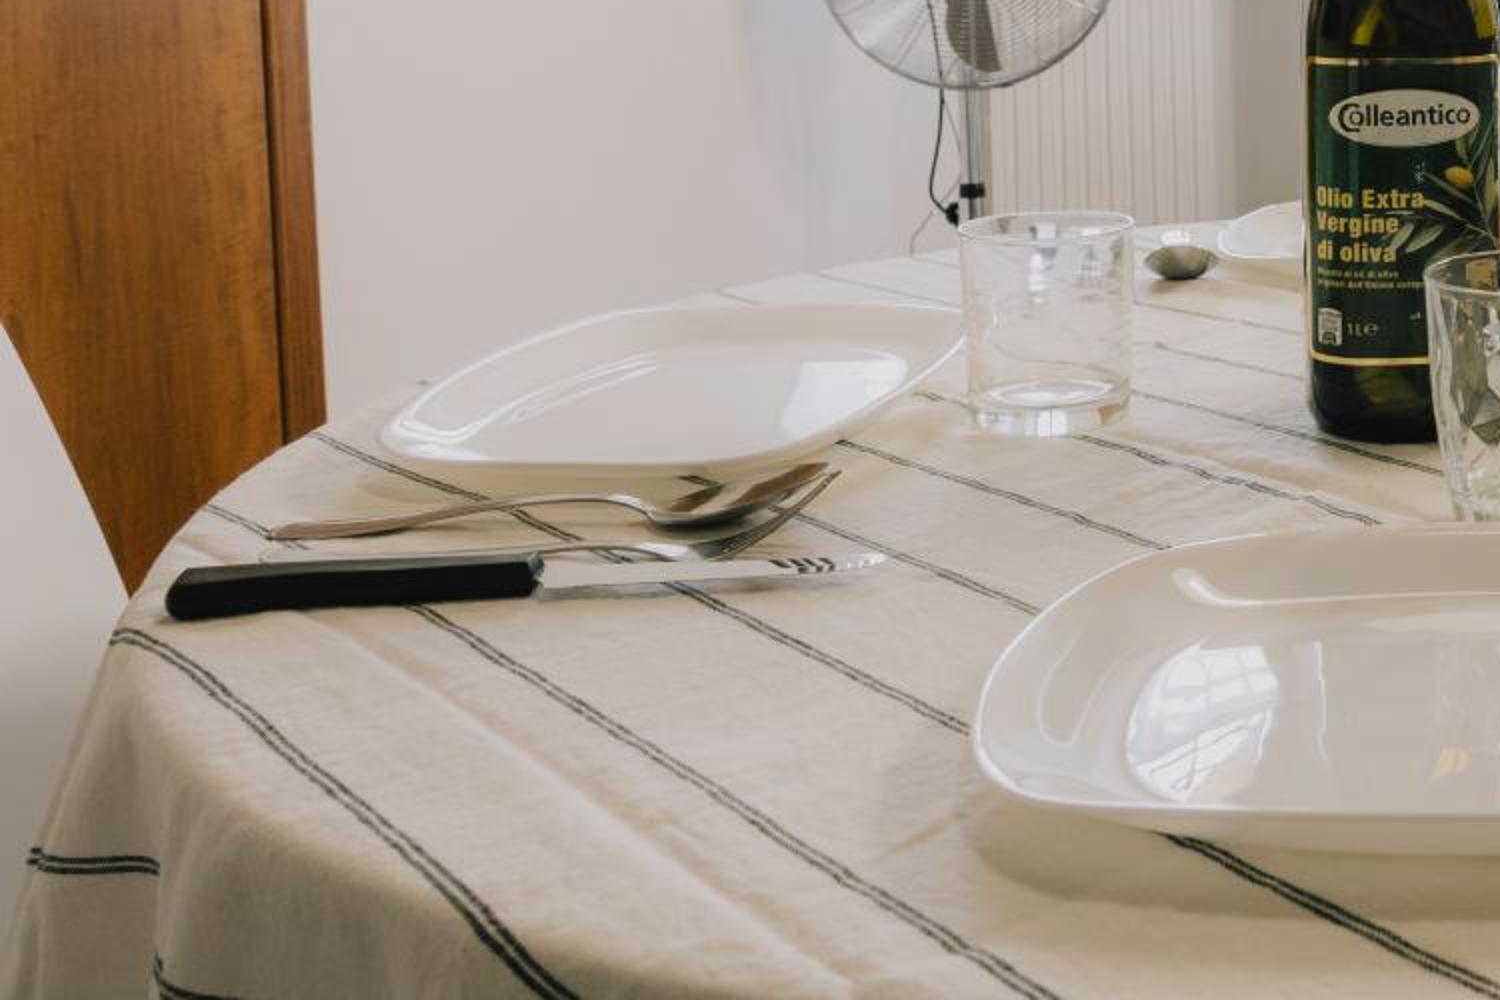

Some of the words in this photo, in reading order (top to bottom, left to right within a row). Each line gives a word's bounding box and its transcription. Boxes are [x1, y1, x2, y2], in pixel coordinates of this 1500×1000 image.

[1338, 103, 1471, 132] Colleantico
[1316, 186, 1352, 209] Olio
[1362, 189, 1425, 209] Extra
[1316, 210, 1400, 237] Vergine
[1316, 240, 1333, 260] di
[1340, 243, 1397, 263] oliva
